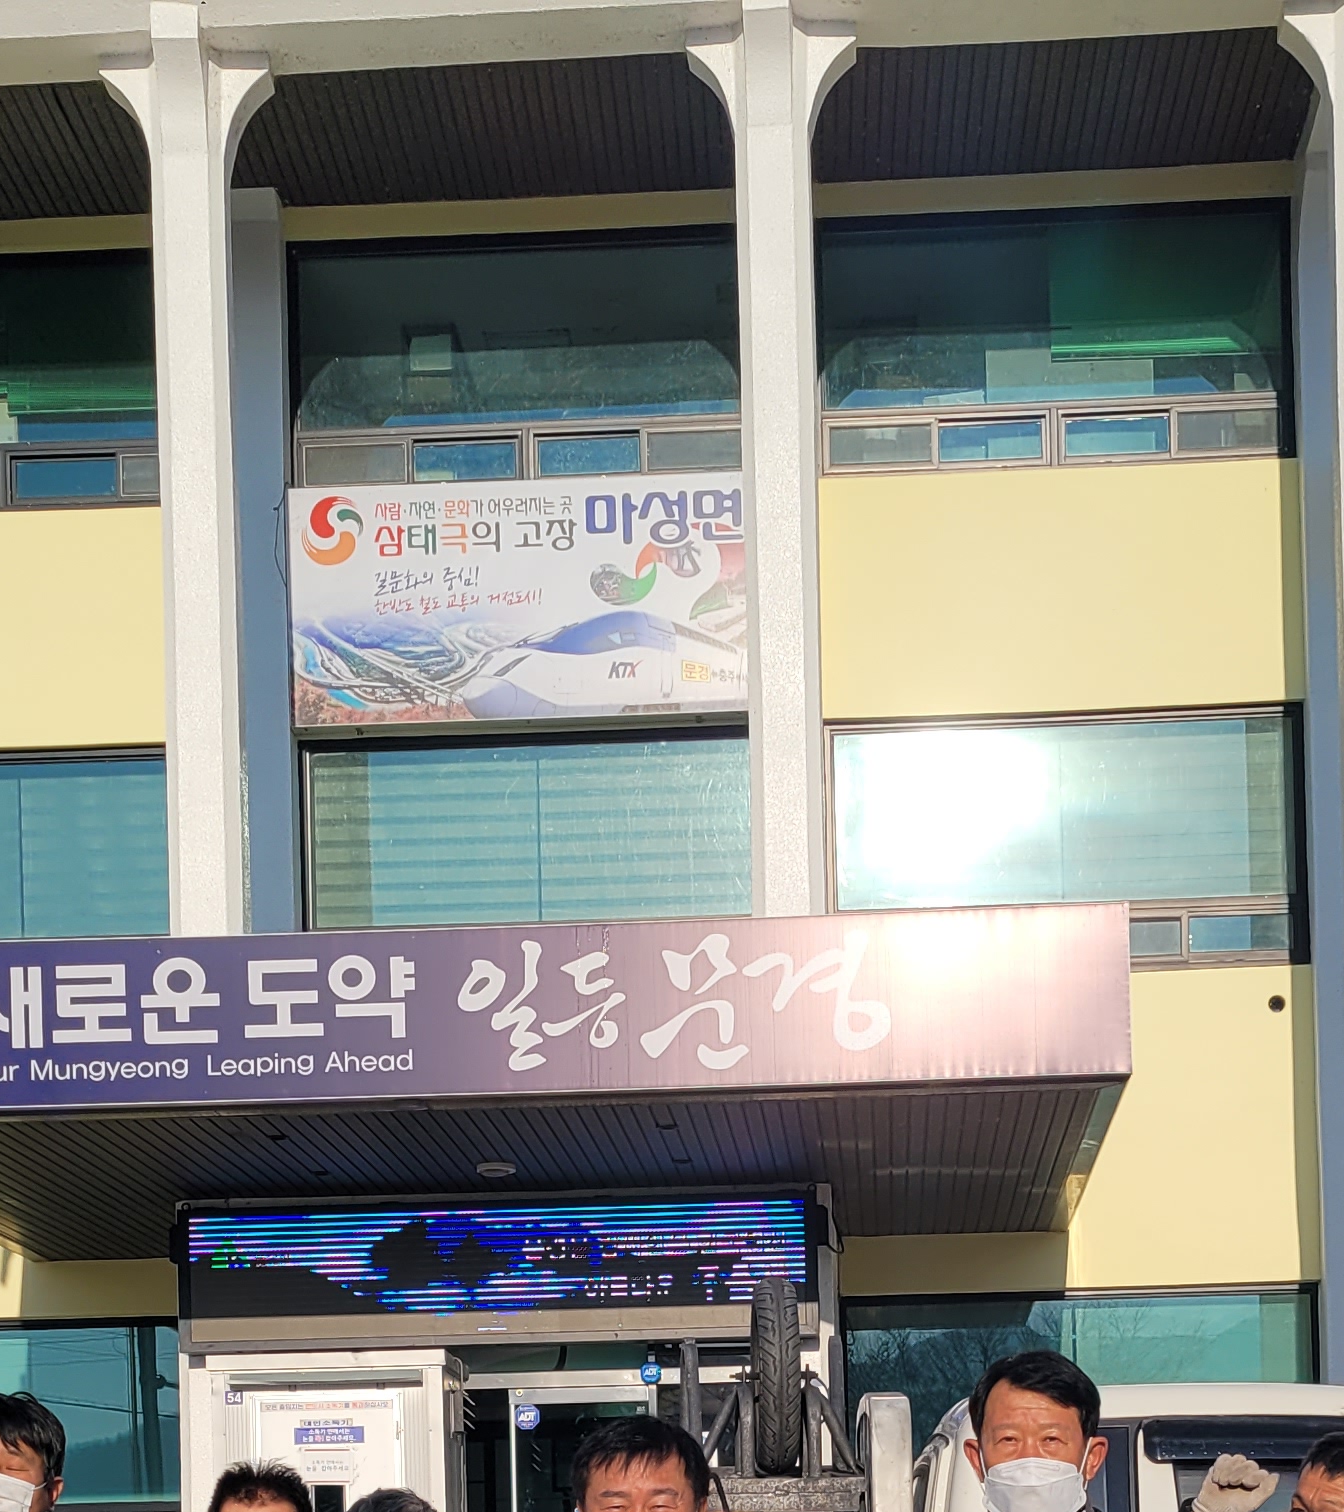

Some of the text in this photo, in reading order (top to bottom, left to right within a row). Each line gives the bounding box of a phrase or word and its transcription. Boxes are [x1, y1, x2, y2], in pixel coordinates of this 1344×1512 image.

[488, 496, 556, 517] 어우러지는
[560, 496, 573, 515] 곳
[585, 489, 744, 545] 마성면
[374, 519, 577, 557] 삼태극의 고장
[374, 566, 479, 597] 길문화의 중심!
[374, 588, 542, 616] 한반도 철도 교통의 거점도시!
[608, 659, 644, 679] KTX
[684, 662, 709, 681] 문경
[244, 955, 416, 1039] 도약
[457, 940, 626, 1071] 일등
[640, 932, 892, 1070] 문경
[30, 1057, 189, 1083] Mungyeong
[207, 1052, 315, 1078] Leaping
[325, 1049, 414, 1074] Ahead
[226, 1393, 242, 1403] 54
[518, 1412, 536, 1422] ADT
